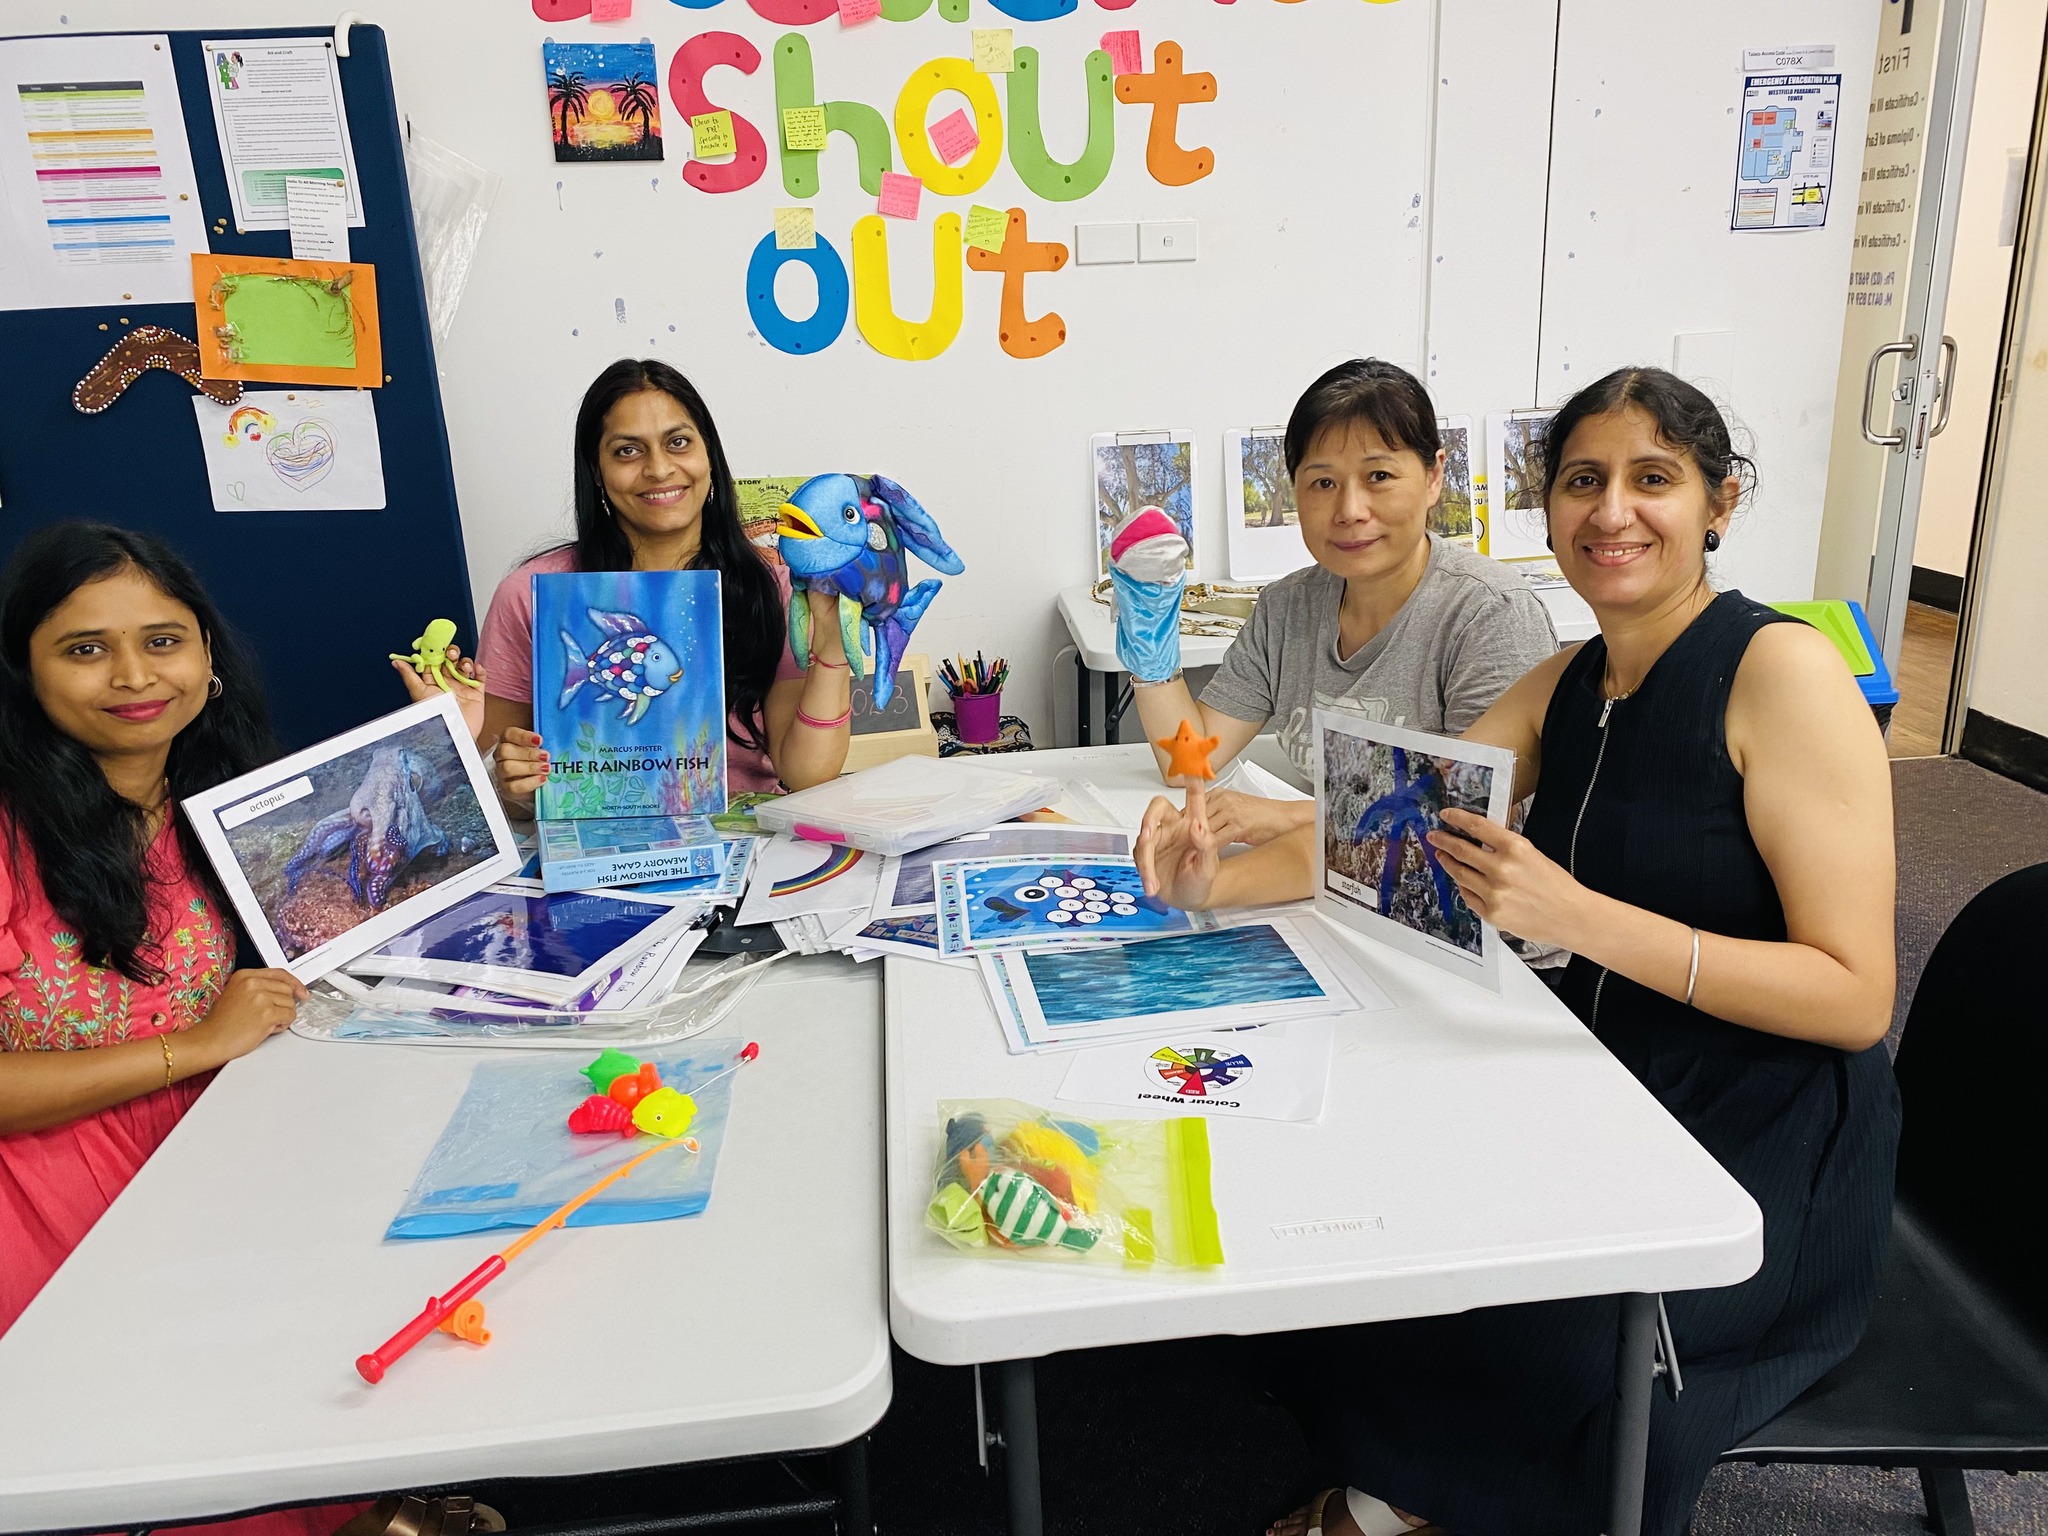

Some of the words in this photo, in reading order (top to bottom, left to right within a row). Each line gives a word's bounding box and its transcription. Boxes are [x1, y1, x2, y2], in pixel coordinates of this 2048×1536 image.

[1776, 57, 1803, 66] C078X
[1751, 77, 1788, 86] EMERGENCY
[1789, 76, 1823, 85] EVACUATION
[669, 32, 1218, 202] Shout
[551, 761, 583, 774] THE
[588, 758, 673, 773] RAINBOW
[676, 757, 709, 770] FISH
[249, 792, 285, 812] octopus
[612, 861, 641, 871] GAME
[643, 856, 689, 868] MEMORY
[620, 868, 669, 881] RAINBOW
[671, 866, 690, 876] THE
[597, 875, 618, 884] FISH
[1341, 881, 1362, 895] starfish
[630, 951, 656, 977] Rainbow
[1138, 1093, 1185, 1104] Wheel
[1189, 1099, 1241, 1108] Colour
